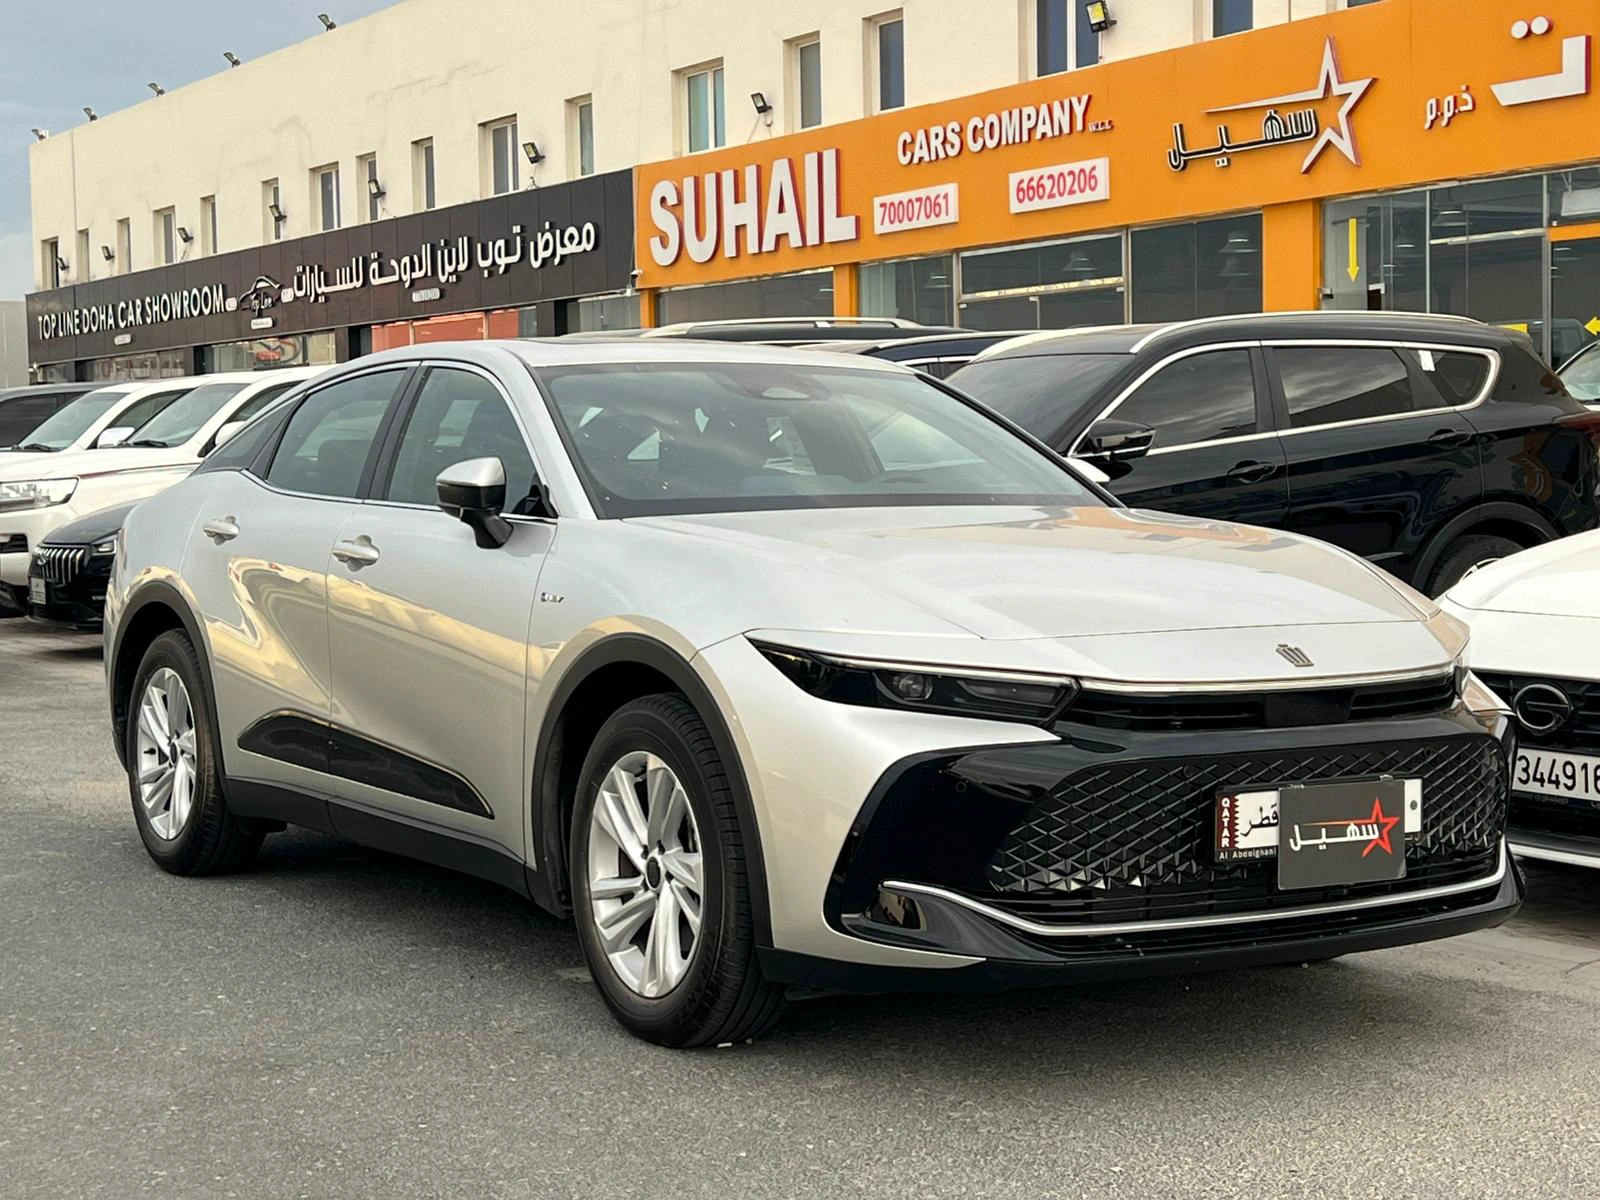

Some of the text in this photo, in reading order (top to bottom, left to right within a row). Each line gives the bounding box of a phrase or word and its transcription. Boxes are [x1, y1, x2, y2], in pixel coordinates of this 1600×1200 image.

[897, 120, 962, 165] CARS
[966, 93, 1092, 153] COMPANY
[1167, 107, 1318, 171] سهيل
[649, 148, 859, 267] SUHAIL
[879, 192, 949, 226] 70007061
[1016, 164, 1098, 204] 66620206
[293, 221, 596, 303] معرض توب لاين الدوحة للسيارات
[38, 313, 57, 340] TOP
[58, 310, 80, 337] LINE
[82, 303, 115, 334] DOHA
[118, 299, 143, 329] CAR
[145, 284, 225, 324] SHOWROOM
[1221, 797, 1231, 848] QATAR
[1240, 803, 1279, 837] قطر
[1289, 822, 1379, 851] سهيل
